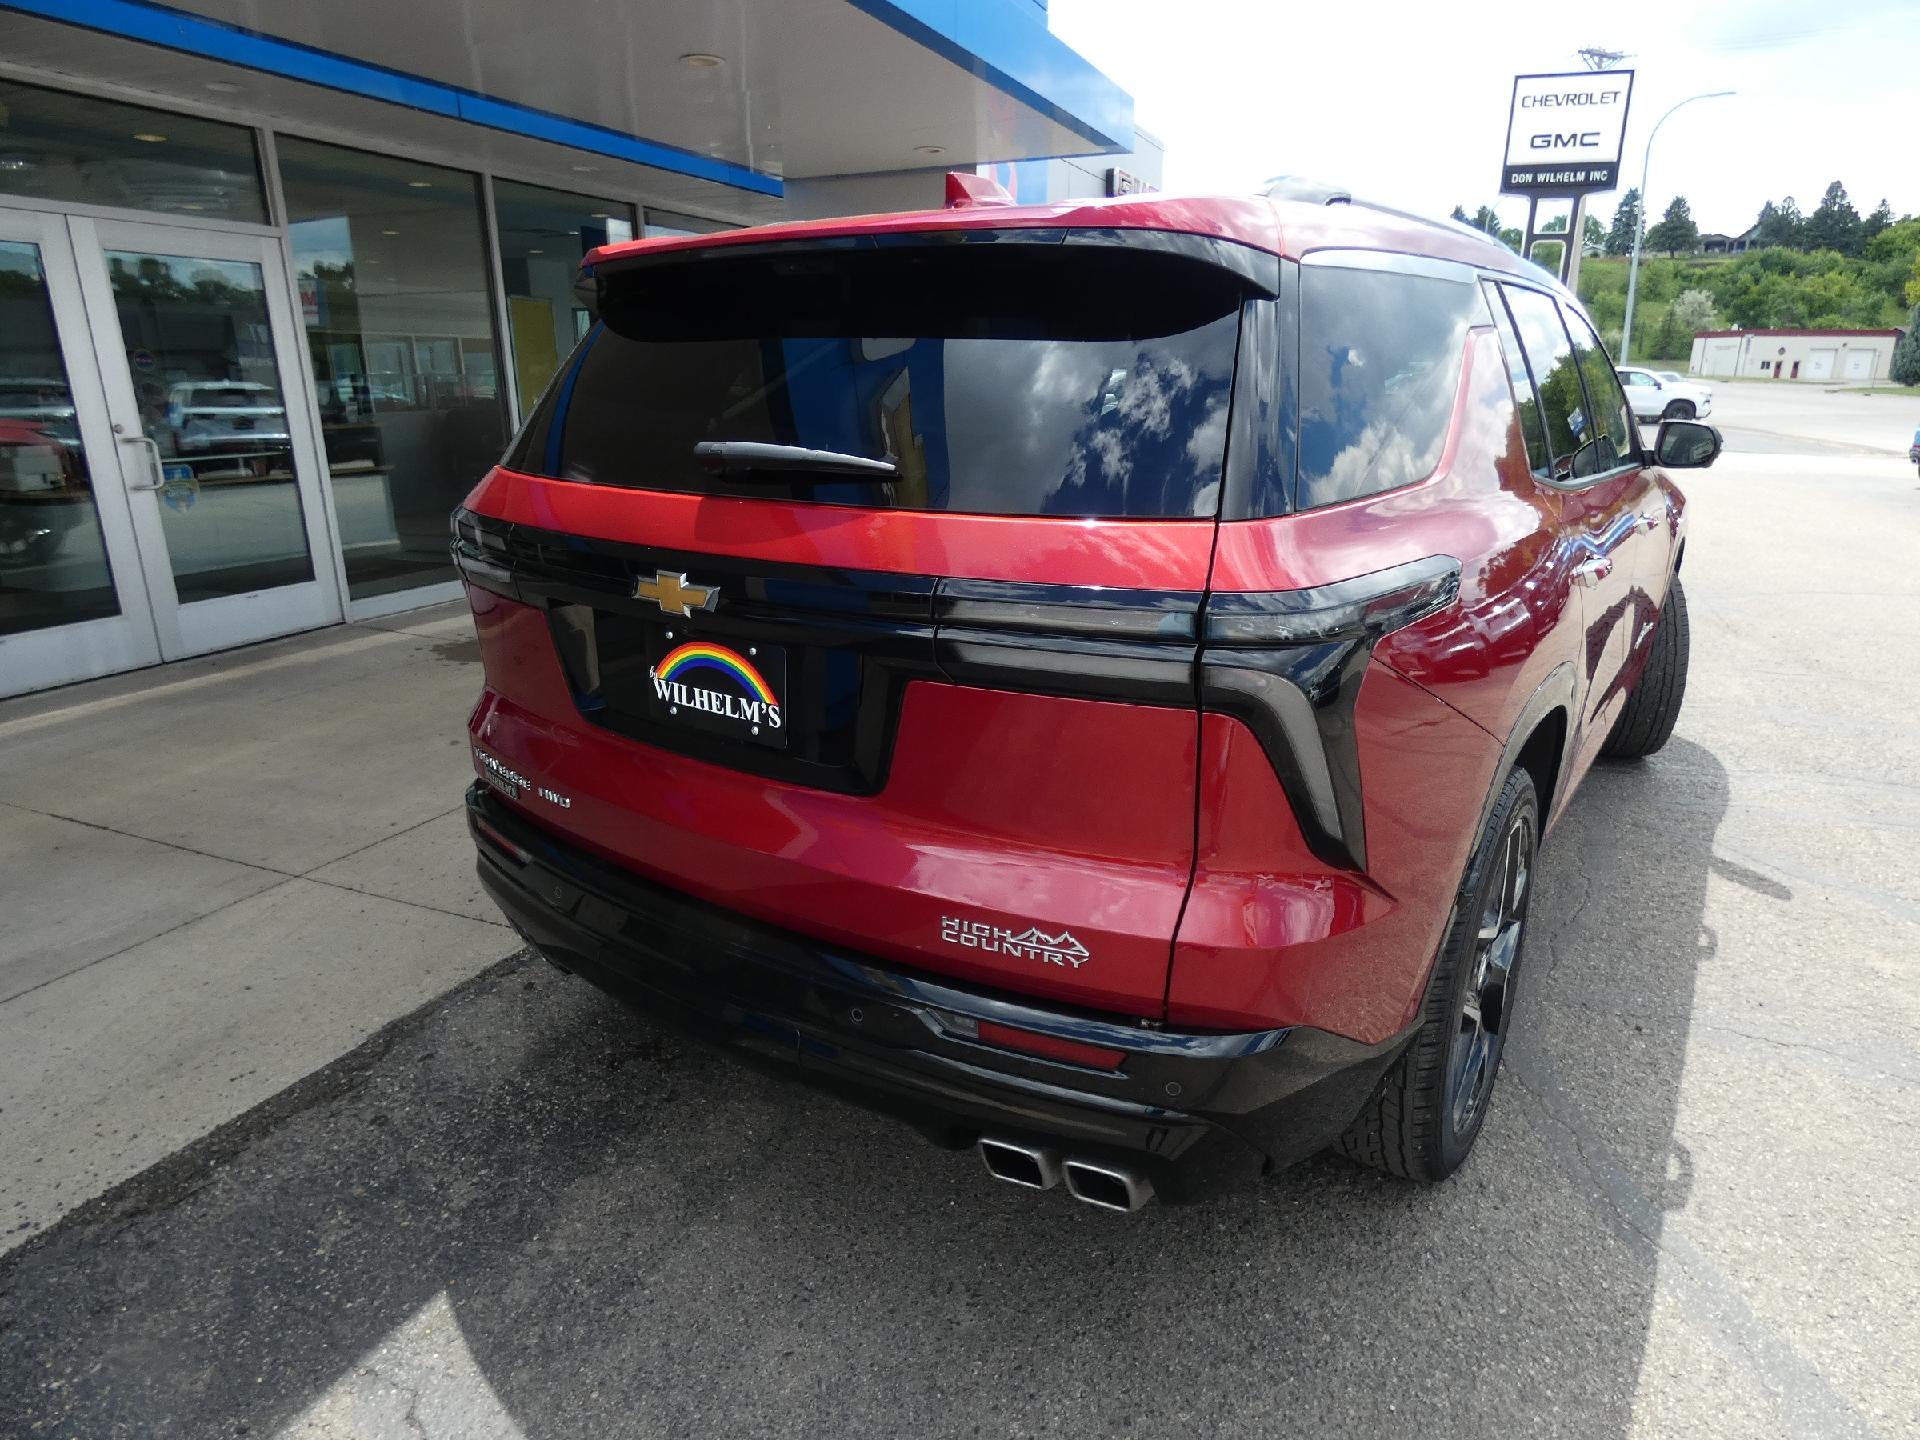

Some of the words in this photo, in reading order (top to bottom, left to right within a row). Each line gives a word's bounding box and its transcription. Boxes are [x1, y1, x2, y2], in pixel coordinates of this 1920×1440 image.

[1521, 91, 1621, 108] CHEVROLET
[1530, 132, 1601, 149] GMC
[1511, 173, 1533, 183] DON
[1537, 171, 1585, 183] WILHELM
[1589, 170, 1608, 182] INC
[653, 678, 782, 728] WILHELM'S
[941, 916, 1012, 942] HIGH
[941, 929, 1089, 969] COUNTRY
